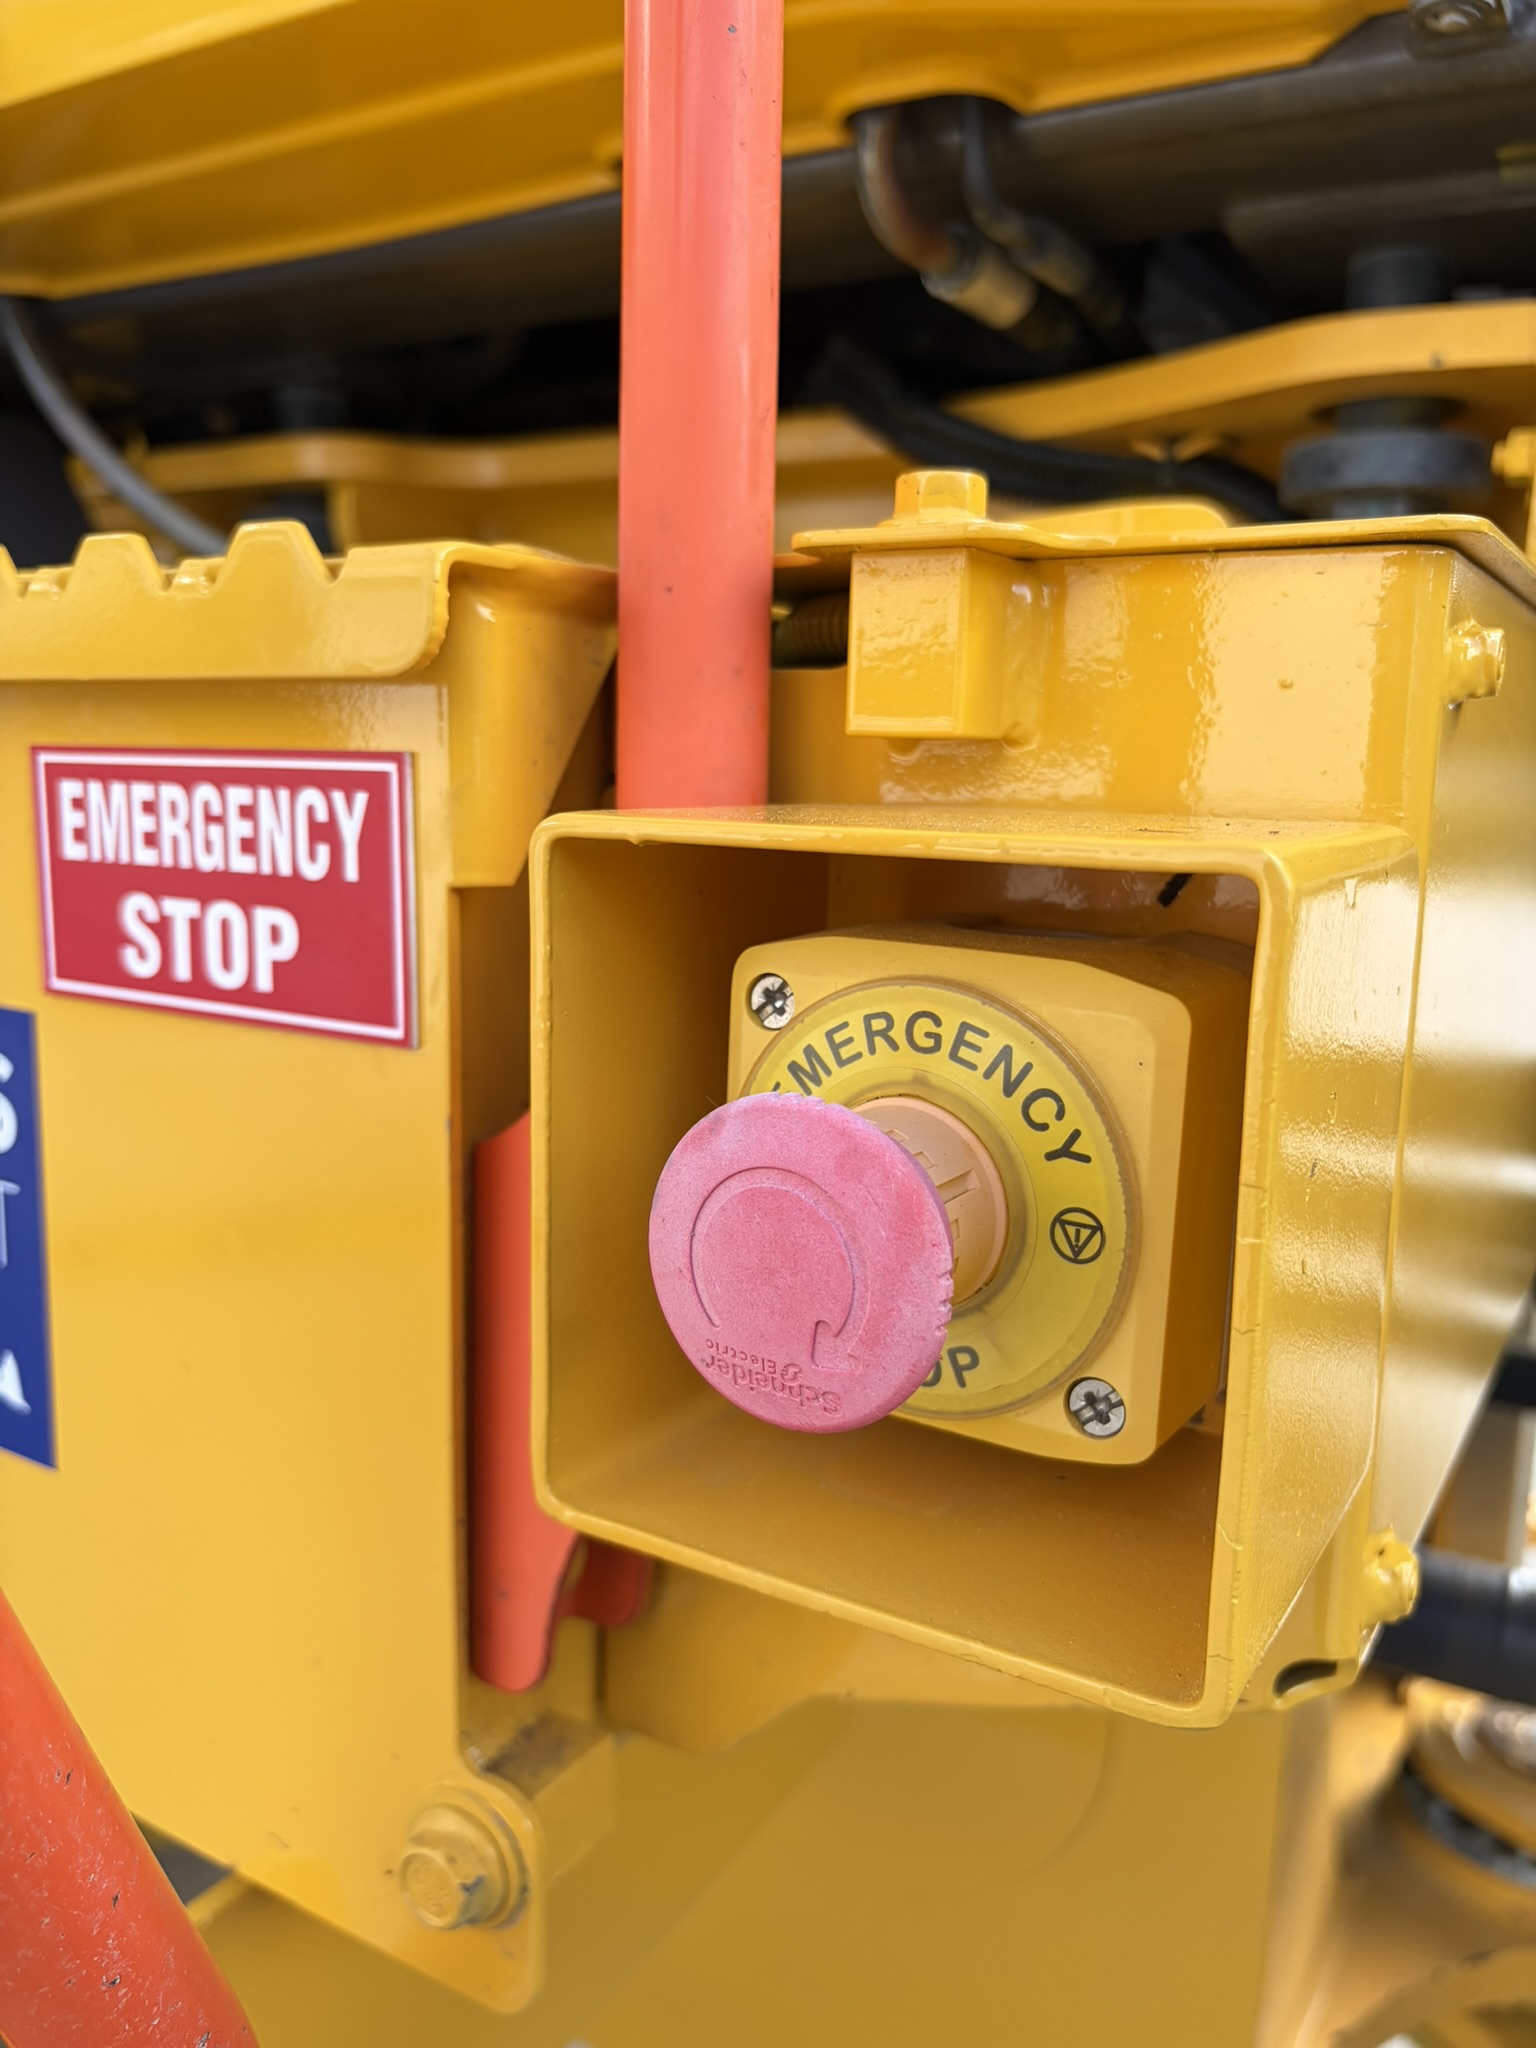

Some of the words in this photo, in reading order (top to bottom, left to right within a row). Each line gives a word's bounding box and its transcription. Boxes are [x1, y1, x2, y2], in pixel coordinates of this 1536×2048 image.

[58, 777, 369, 882] EMERGENCY
[119, 891, 300, 993] STOP
[771, 1010, 1092, 1164] MERGENCY
[702, 1354, 842, 1415] Schneider
[705, 1338, 777, 1375] Electric
